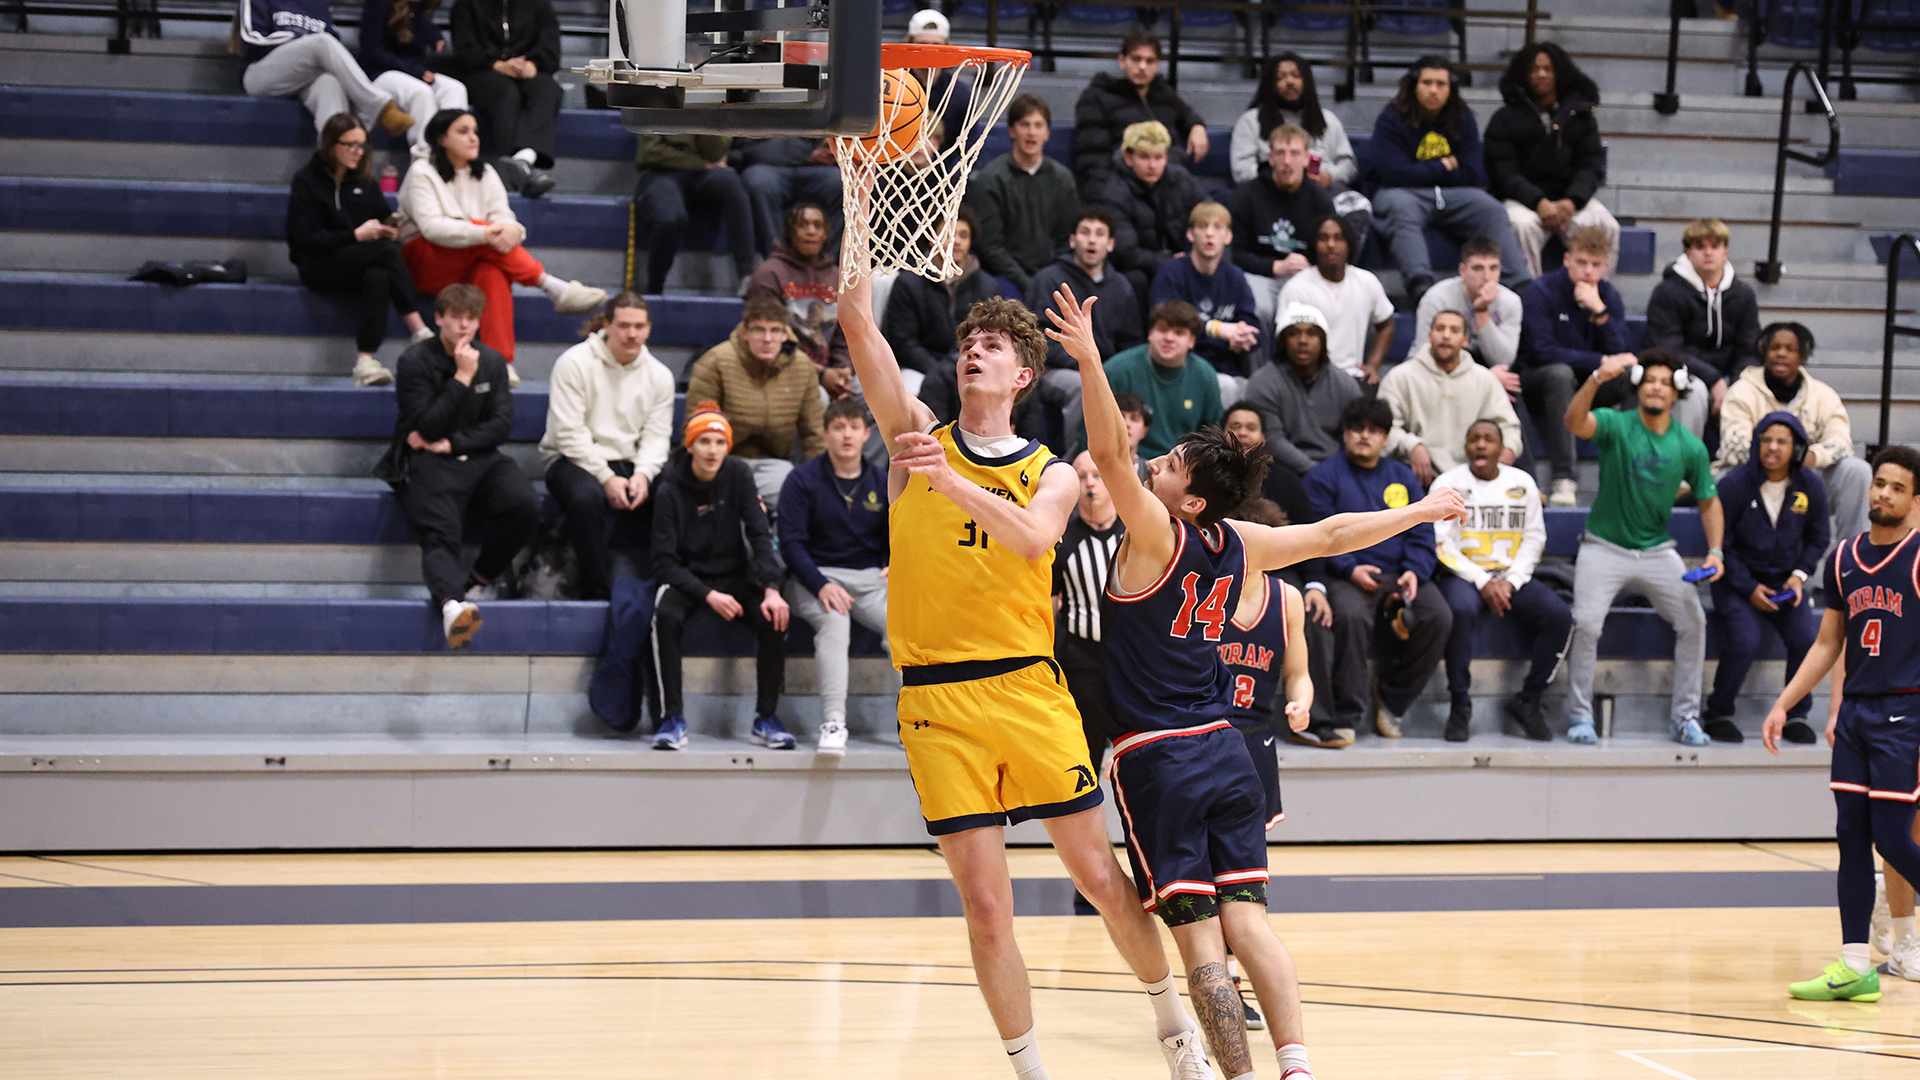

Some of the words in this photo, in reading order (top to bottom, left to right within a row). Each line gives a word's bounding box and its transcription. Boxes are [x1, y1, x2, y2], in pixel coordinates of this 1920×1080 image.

[1170, 571, 1234, 641] 14
[1847, 585, 1903, 619] HIRAM
[1861, 618, 1882, 657] 4
[1216, 642, 1274, 671] IRAM
